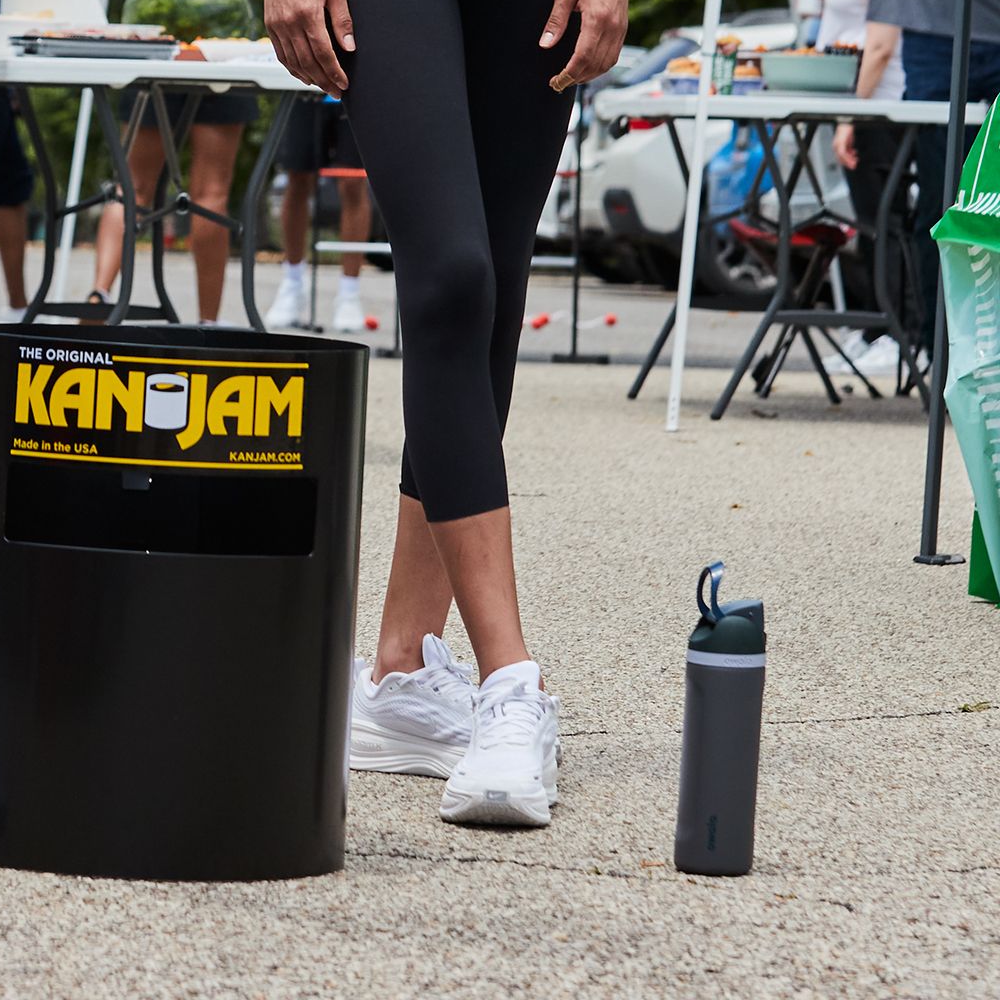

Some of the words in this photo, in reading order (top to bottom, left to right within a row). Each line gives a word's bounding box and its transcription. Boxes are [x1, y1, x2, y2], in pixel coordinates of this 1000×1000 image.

[19, 346, 42, 360] THE
[45, 348, 113, 365] ORIGINAL
[13, 438, 39, 450] Made
[41, 440, 51, 451] in
[53, 441, 71, 453] the
[74, 442, 98, 455] USA
[229, 451, 301, 463] KANJAM.COM
